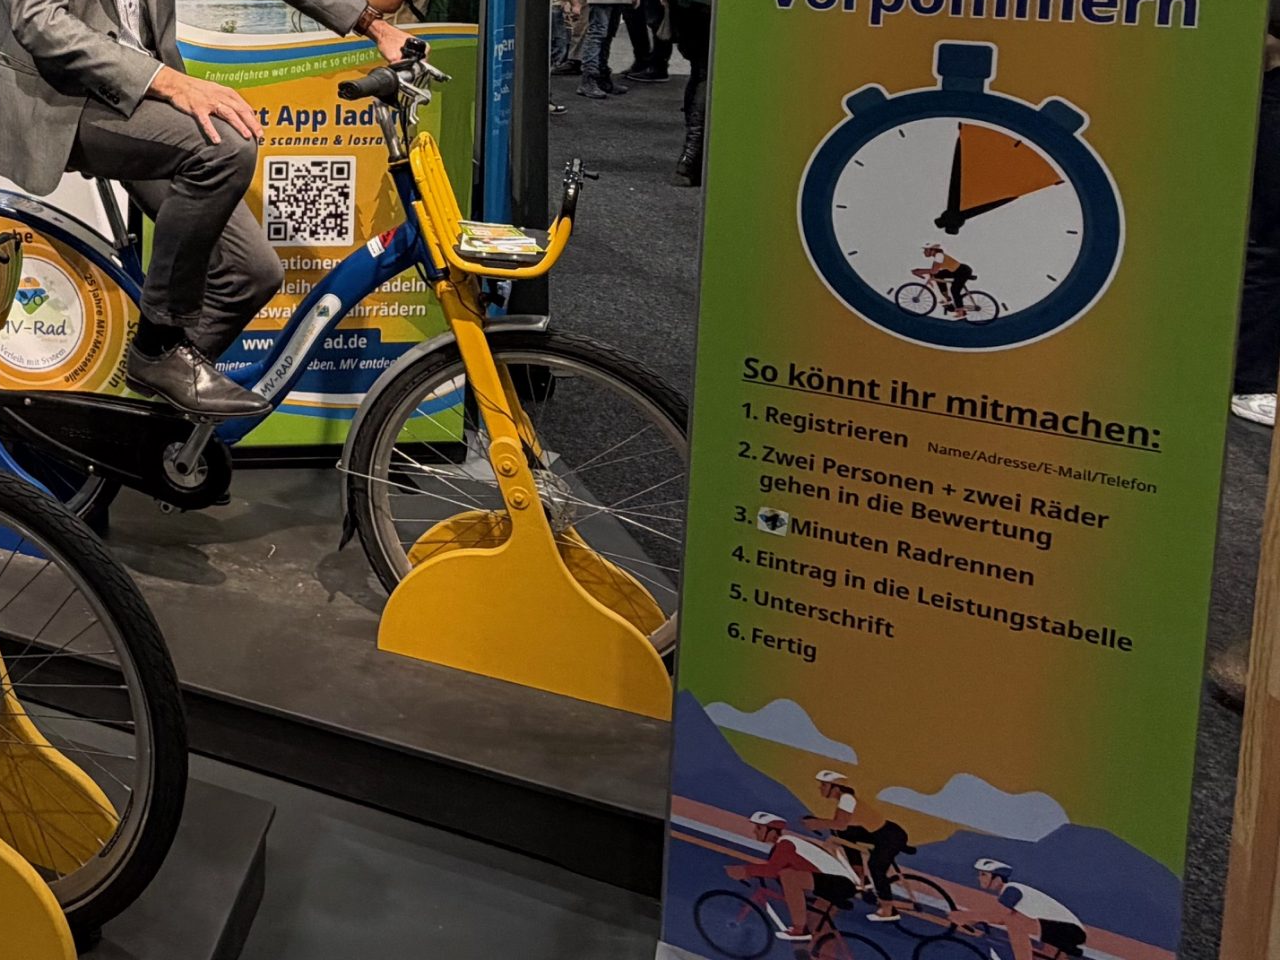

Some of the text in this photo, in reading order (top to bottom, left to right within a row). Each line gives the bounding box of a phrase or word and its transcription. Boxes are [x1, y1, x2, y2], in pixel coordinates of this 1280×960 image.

[205, 69, 270, 84] Fahrradfahren
[272, 66, 289, 77] war
[290, 63, 312, 74] noch
[314, 60, 328, 71] nie
[330, 58, 341, 67] so
[341, 49, 376, 66] einfach
[277, 105, 328, 132] App
[270, 134, 328, 147] scannen
[333, 134, 344, 147] &
[84, 273, 96, 287] 25
[89, 288, 105, 316] Jahre
[0, 344, 25, 365] Verleih
[26, 358, 41, 366] mit
[260, 354, 294, 398] MV-RAD
[339, 358, 358, 371] MV
[743, 356, 1162, 449] So könnt ihr mitmachen:
[741, 402, 1158, 494] 1. Registrieren Name/Adresse/E-Mail/Telefon
[738, 441, 1110, 529] 2. Zwei Personen + zwei Räder
[759, 474, 1053, 551] gehen in die Bewertung
[734, 505, 1035, 586] 3. Minuten Radrennen
[729, 582, 895, 638] 5. Unterschrift
[731, 545, 1134, 652] 4. Eintrag in die Leistungstabelle
[727, 621, 818, 663] 6. Fertig
